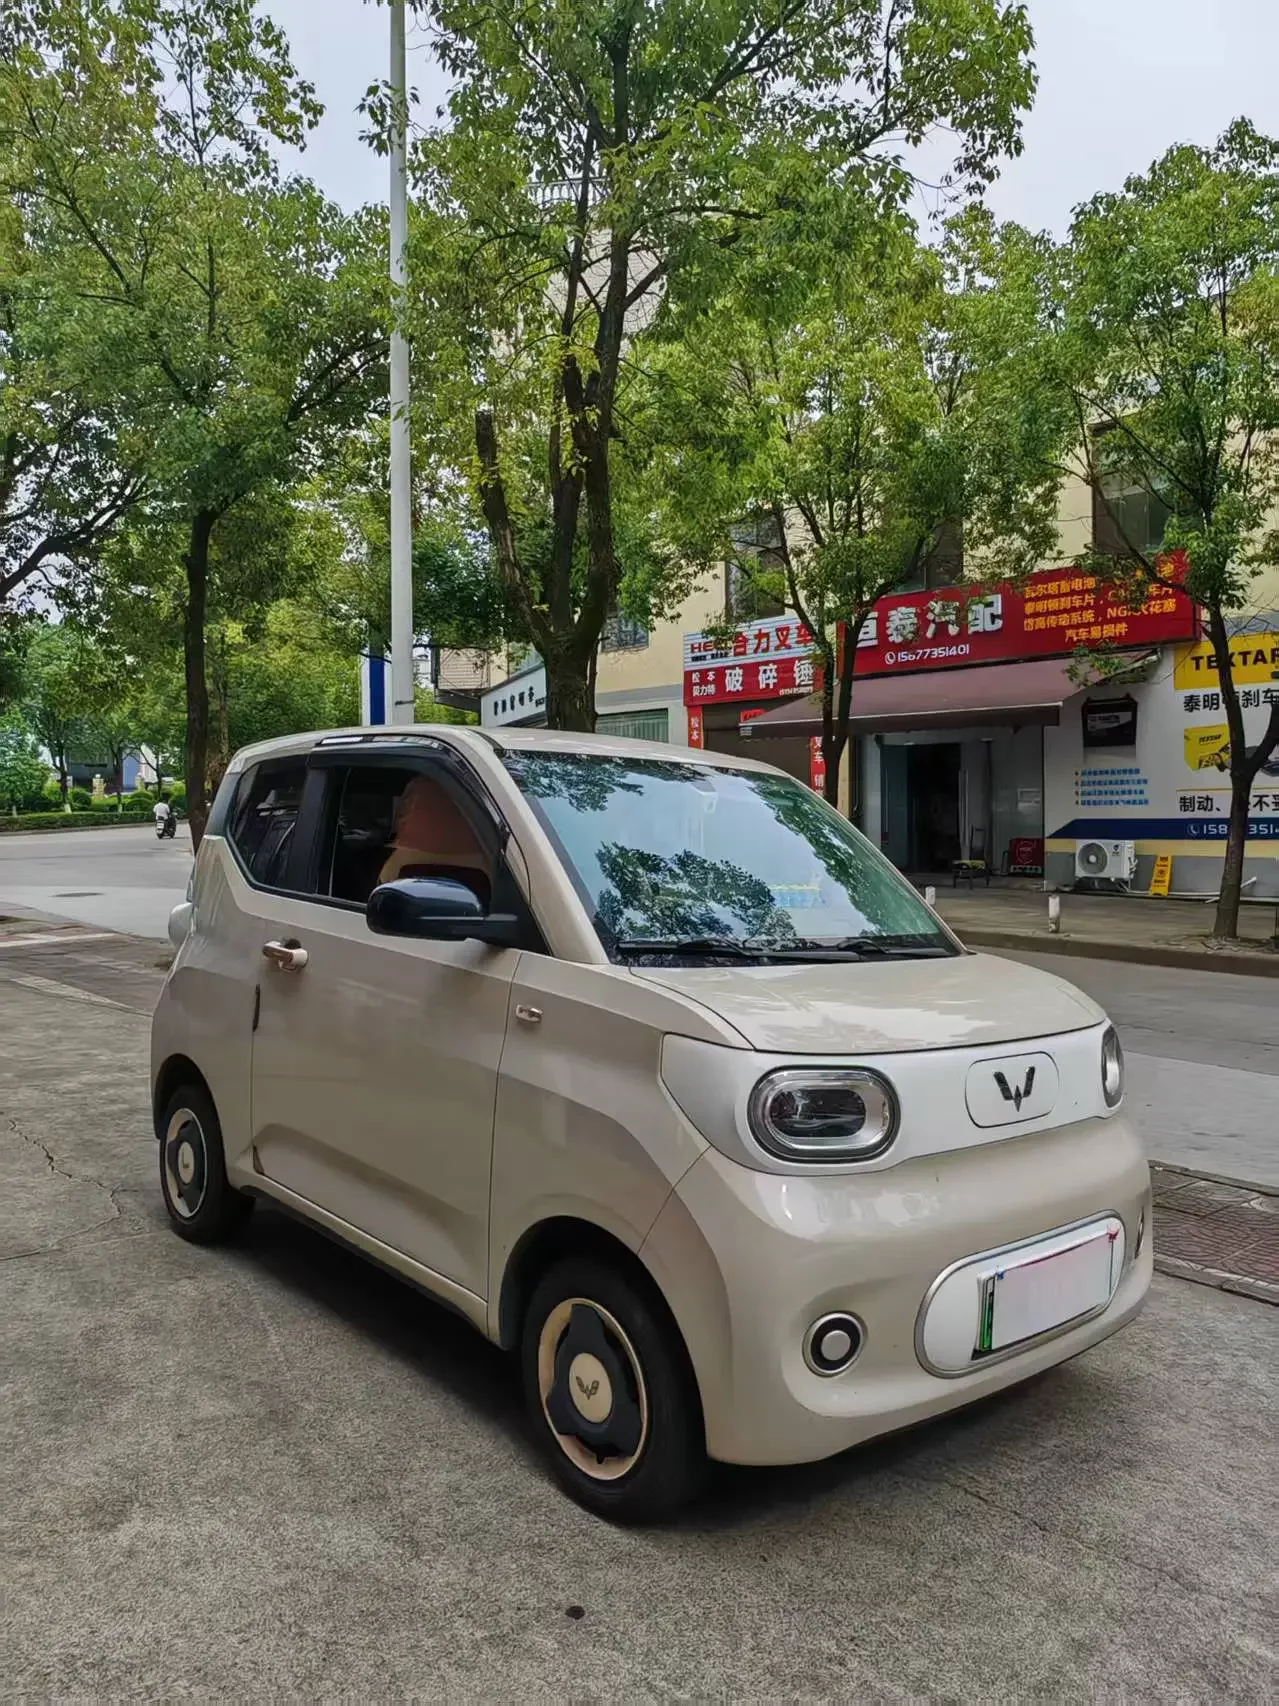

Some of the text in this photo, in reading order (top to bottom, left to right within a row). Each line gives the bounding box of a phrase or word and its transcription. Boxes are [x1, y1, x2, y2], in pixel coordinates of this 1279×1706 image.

[733, 623, 813, 656] 合力叉车
[1183, 688, 1279, 713] 泰明刹车
[1203, 824, 1279, 835] 158351
